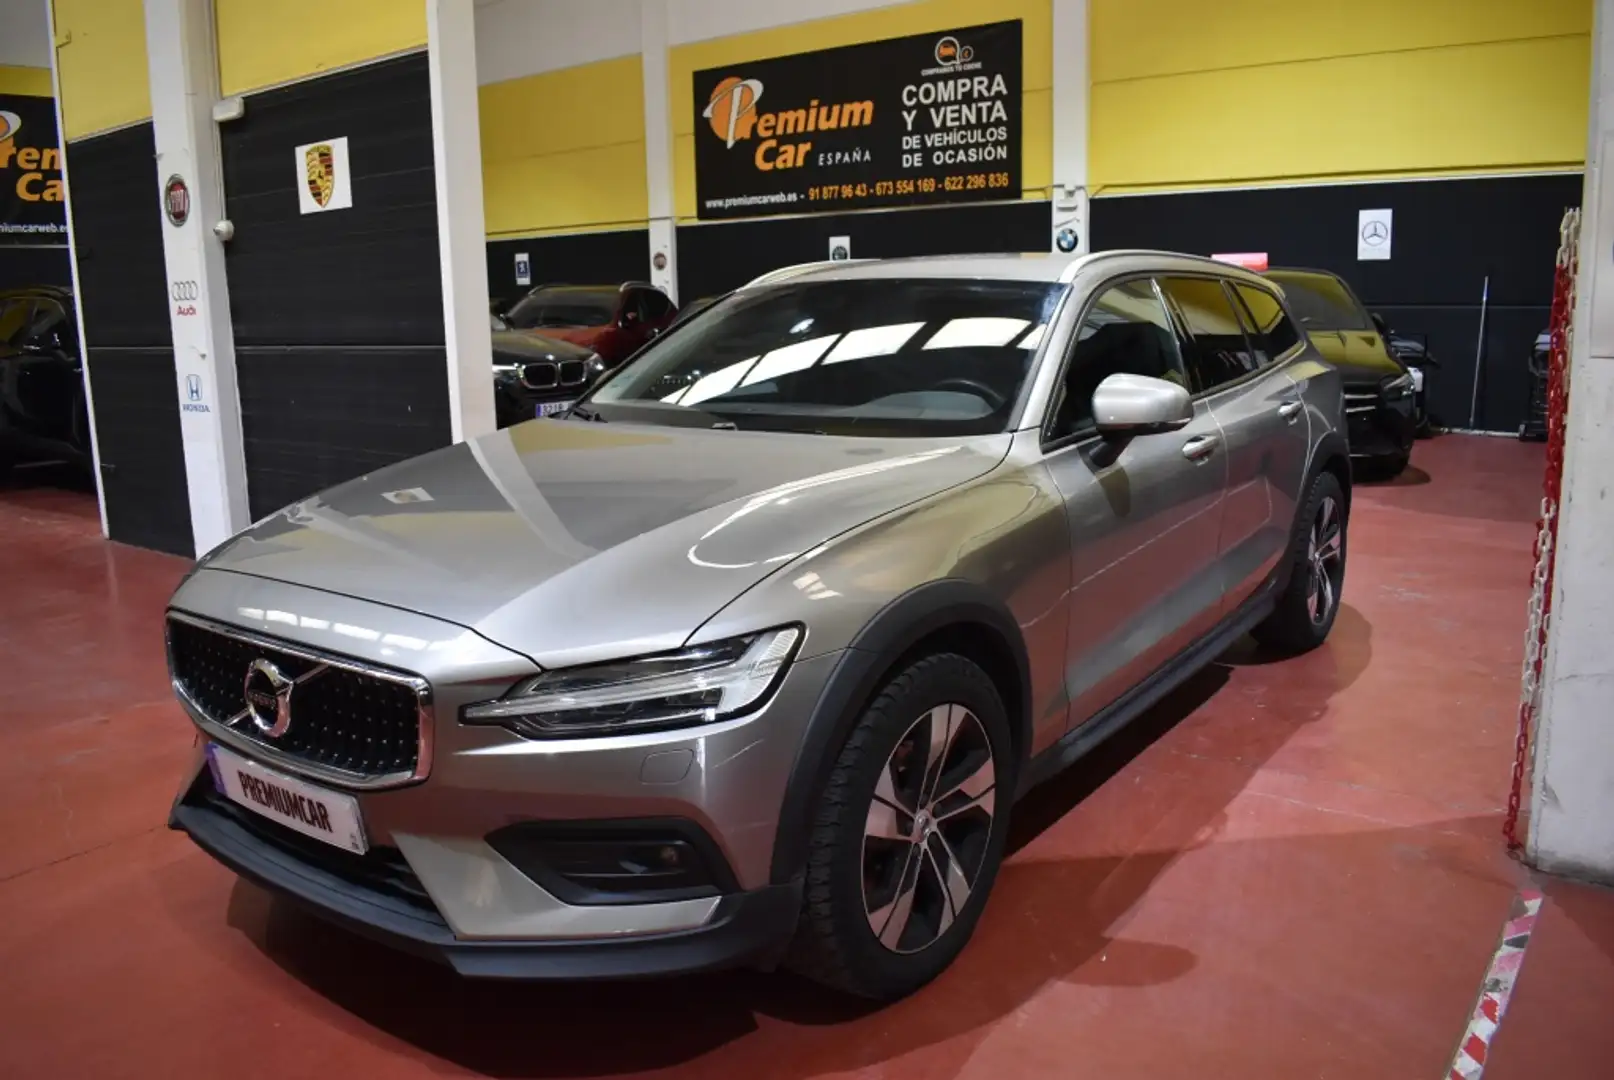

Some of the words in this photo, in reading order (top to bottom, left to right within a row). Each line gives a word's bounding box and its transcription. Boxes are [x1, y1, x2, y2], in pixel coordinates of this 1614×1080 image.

[902, 74, 1008, 106] COMPRA
[703, 78, 874, 149] Premium
[902, 109, 917, 131] Y
[930, 100, 1008, 128] VENTA
[902, 135, 921, 150] DE
[924, 126, 1007, 147] VEHÍCULOS
[755, 139, 811, 171] Car
[818, 147, 871, 166] ESPAÑA
[902, 153, 923, 168] DE
[933, 144, 1007, 165] OCASIÓN
[705, 192, 797, 210] www.premiumcarweb.es
[808, 187, 819, 200] 91
[822, 185, 839, 199] 877
[841, 184, 853, 198] 96
[855, 183, 867, 197] 43
[876, 181, 893, 195] 673
[896, 179, 914, 194] 554
[917, 178, 936, 192] 169
[944, 176, 965, 191] 622
[966, 174, 986, 189] 296
[988, 172, 1009, 188] 836
[177, 305, 197, 316] Audi
[182, 403, 211, 413] HONDA
[237, 770, 333, 833] PREMIUMCAR
